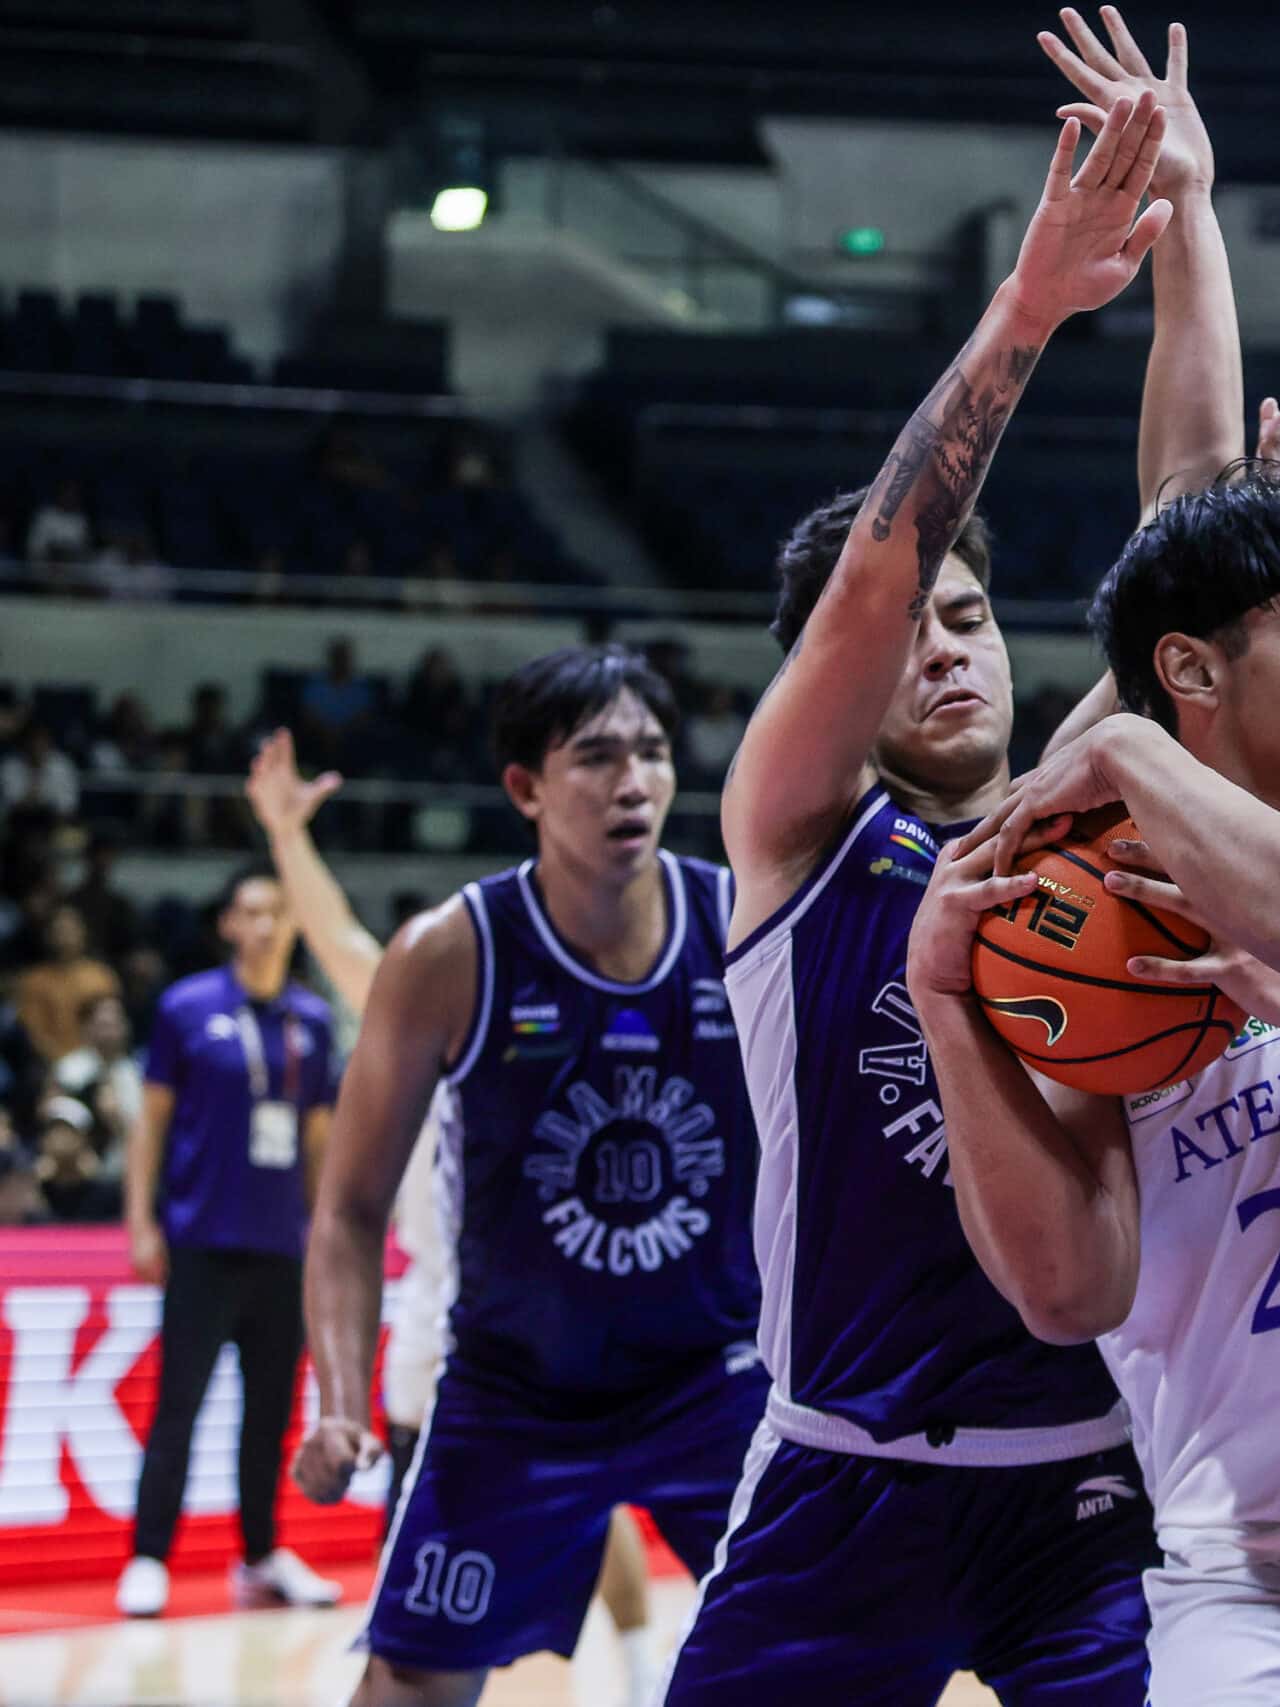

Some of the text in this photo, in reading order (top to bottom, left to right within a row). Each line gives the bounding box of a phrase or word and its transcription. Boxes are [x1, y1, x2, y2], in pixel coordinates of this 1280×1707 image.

[593, 1141, 663, 1202] 10
[542, 1196, 711, 1277] FALCONS
[1076, 1493, 1114, 1521] ANTA
[404, 1541, 495, 1624] 10
